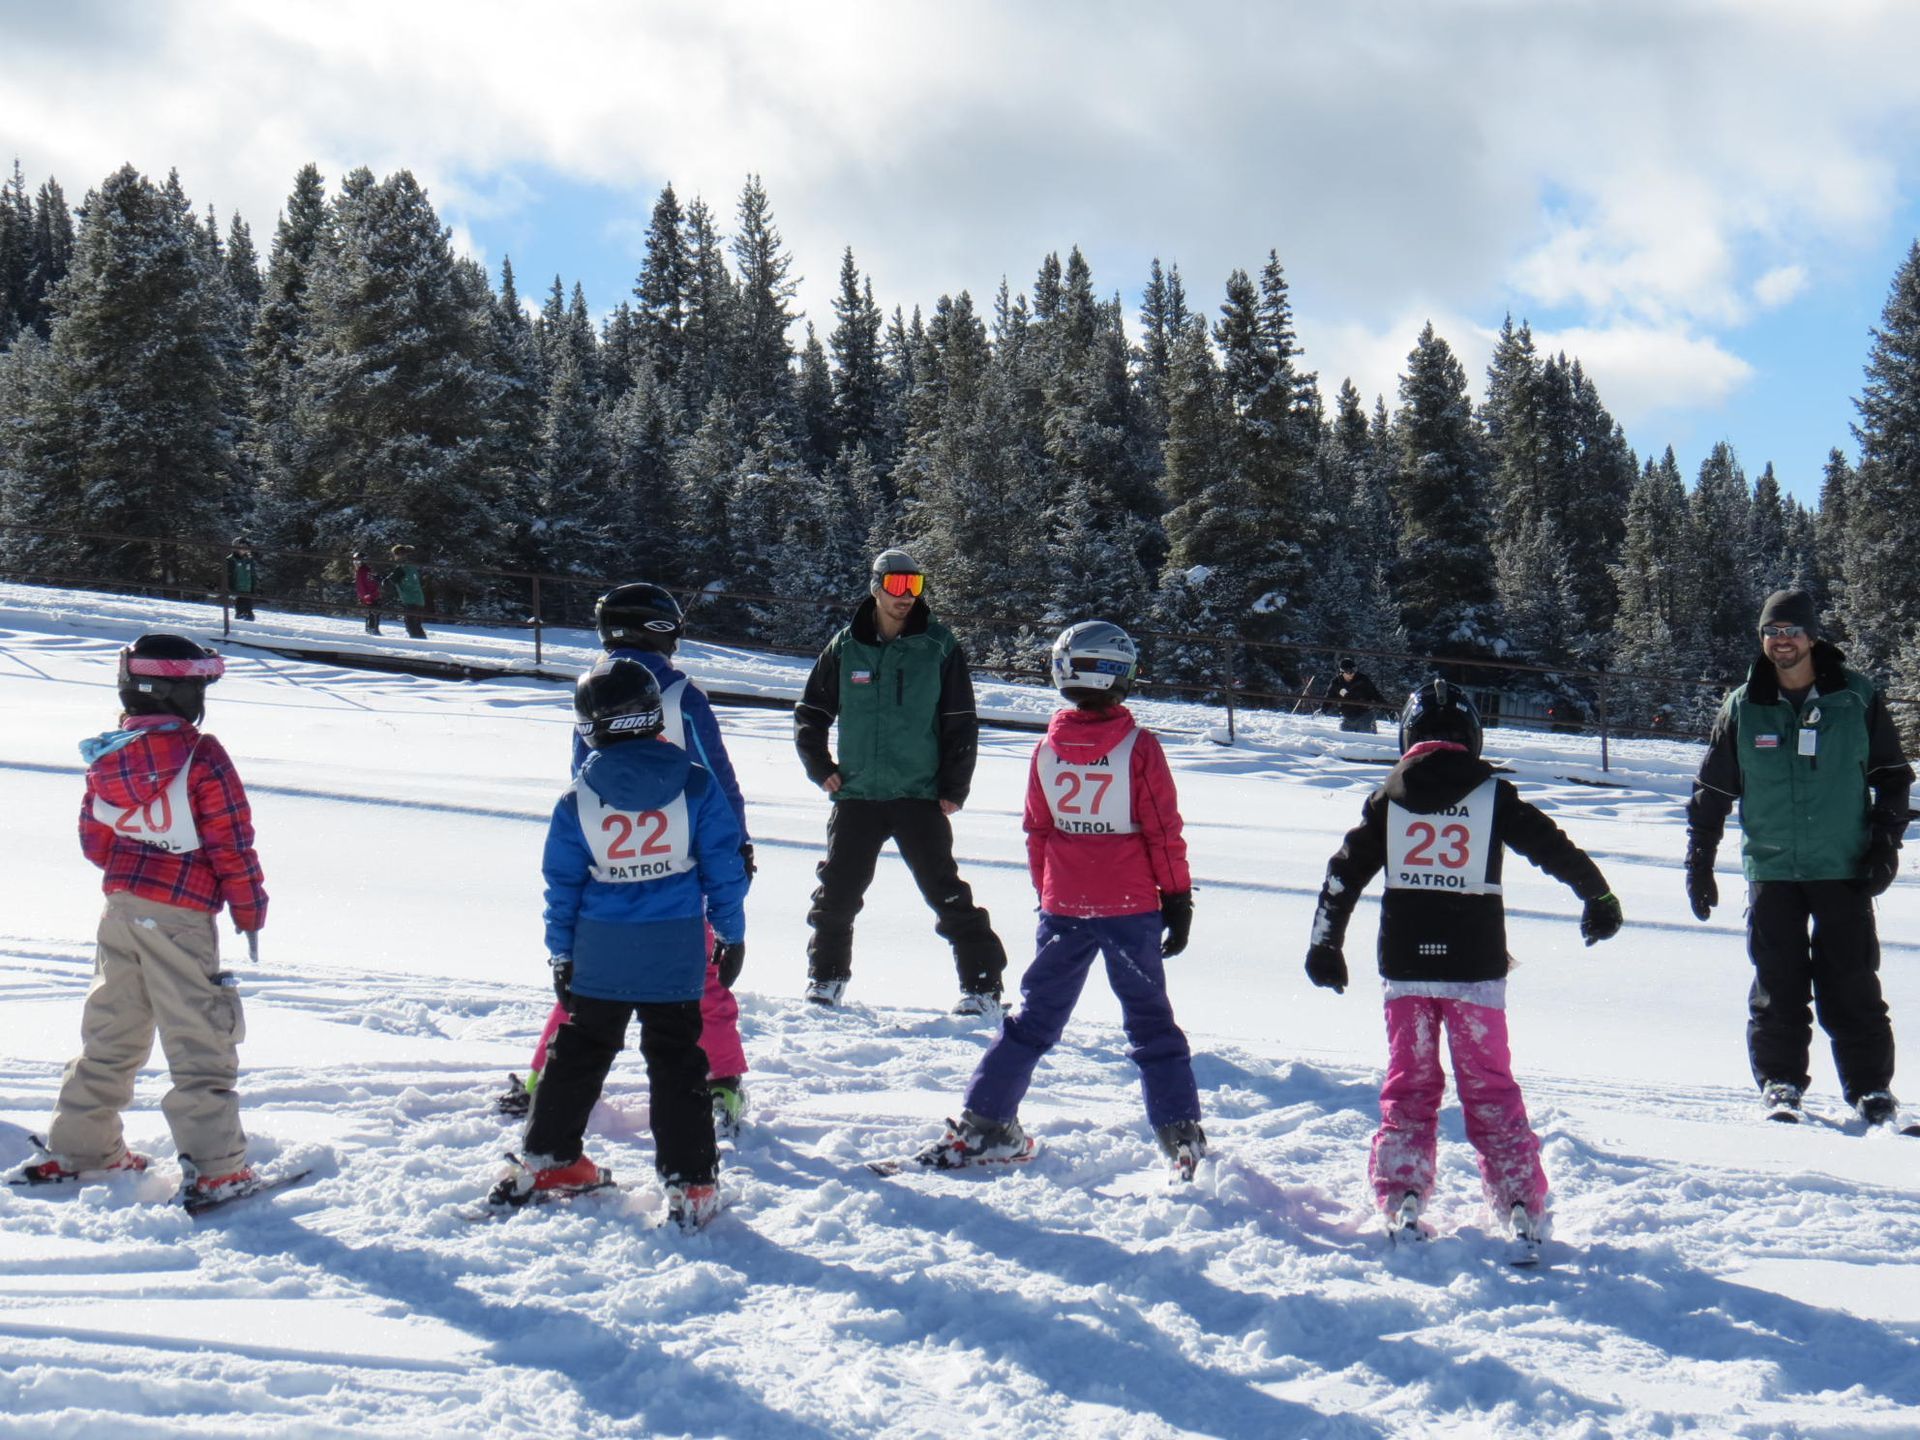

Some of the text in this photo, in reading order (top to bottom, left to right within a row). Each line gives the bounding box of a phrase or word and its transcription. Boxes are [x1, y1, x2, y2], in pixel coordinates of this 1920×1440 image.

[115, 789, 172, 833] 20
[1055, 771, 1113, 815] 27
[601, 810, 672, 860] 22
[1058, 818, 1115, 833] PATROL
[1403, 821, 1470, 870] 23
[610, 860, 672, 879] PATROL
[1400, 872, 1467, 889] PATROL
